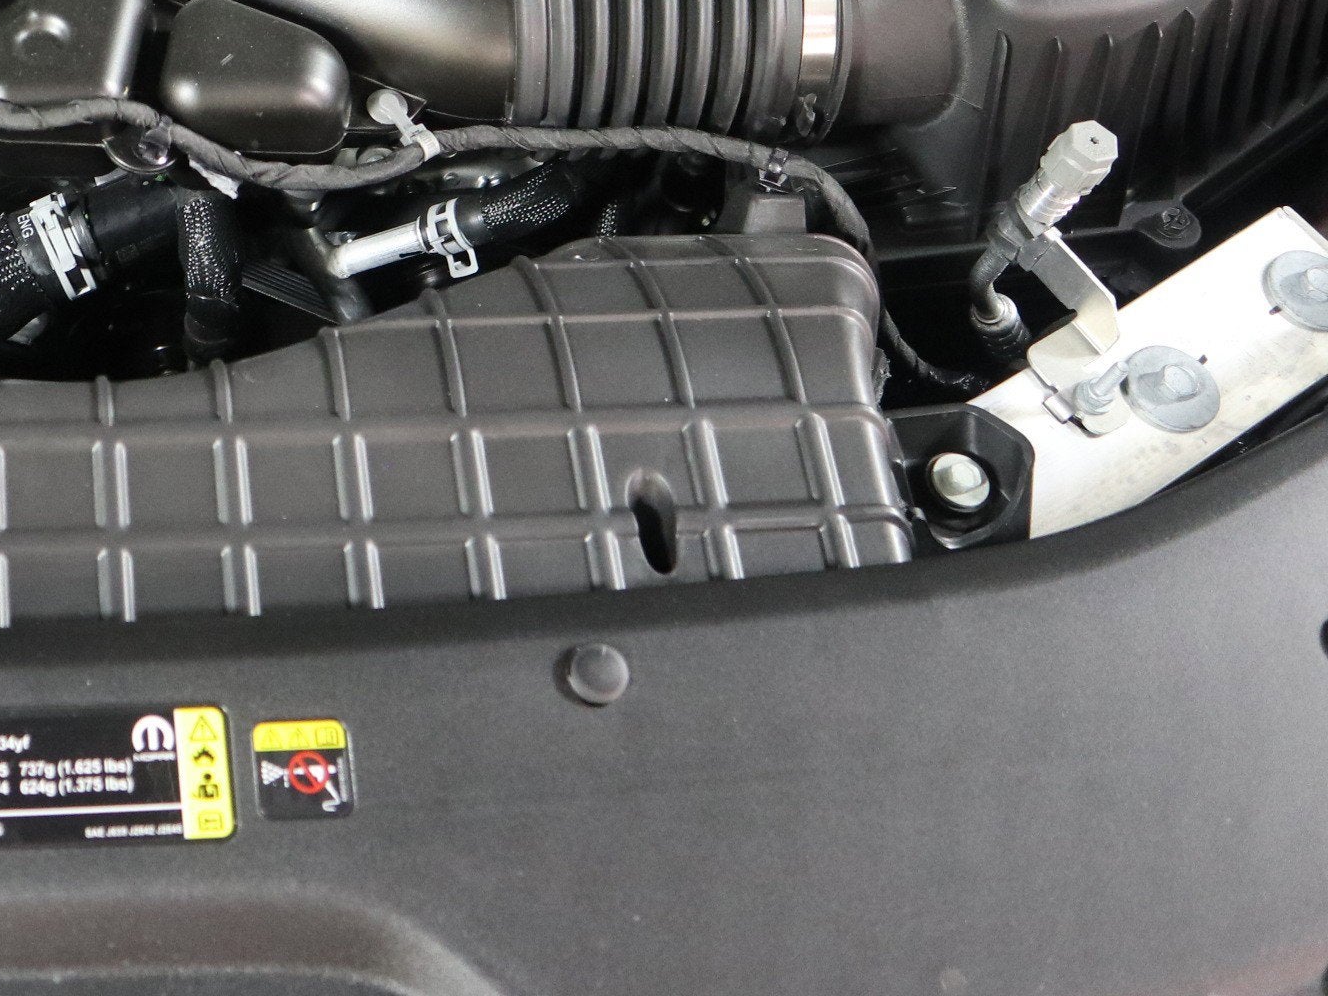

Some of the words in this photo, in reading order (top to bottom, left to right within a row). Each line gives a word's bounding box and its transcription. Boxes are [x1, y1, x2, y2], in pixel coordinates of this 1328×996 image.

[17, 213, 35, 239] ENG
[18, 761, 56, 779] 737g
[57, 758, 102, 778] (1.625
[104, 757, 133, 776] lbs)
[19, 779, 57, 798] 624g
[58, 777, 103, 797] (1.375
[105, 775, 135, 794] lbs)
